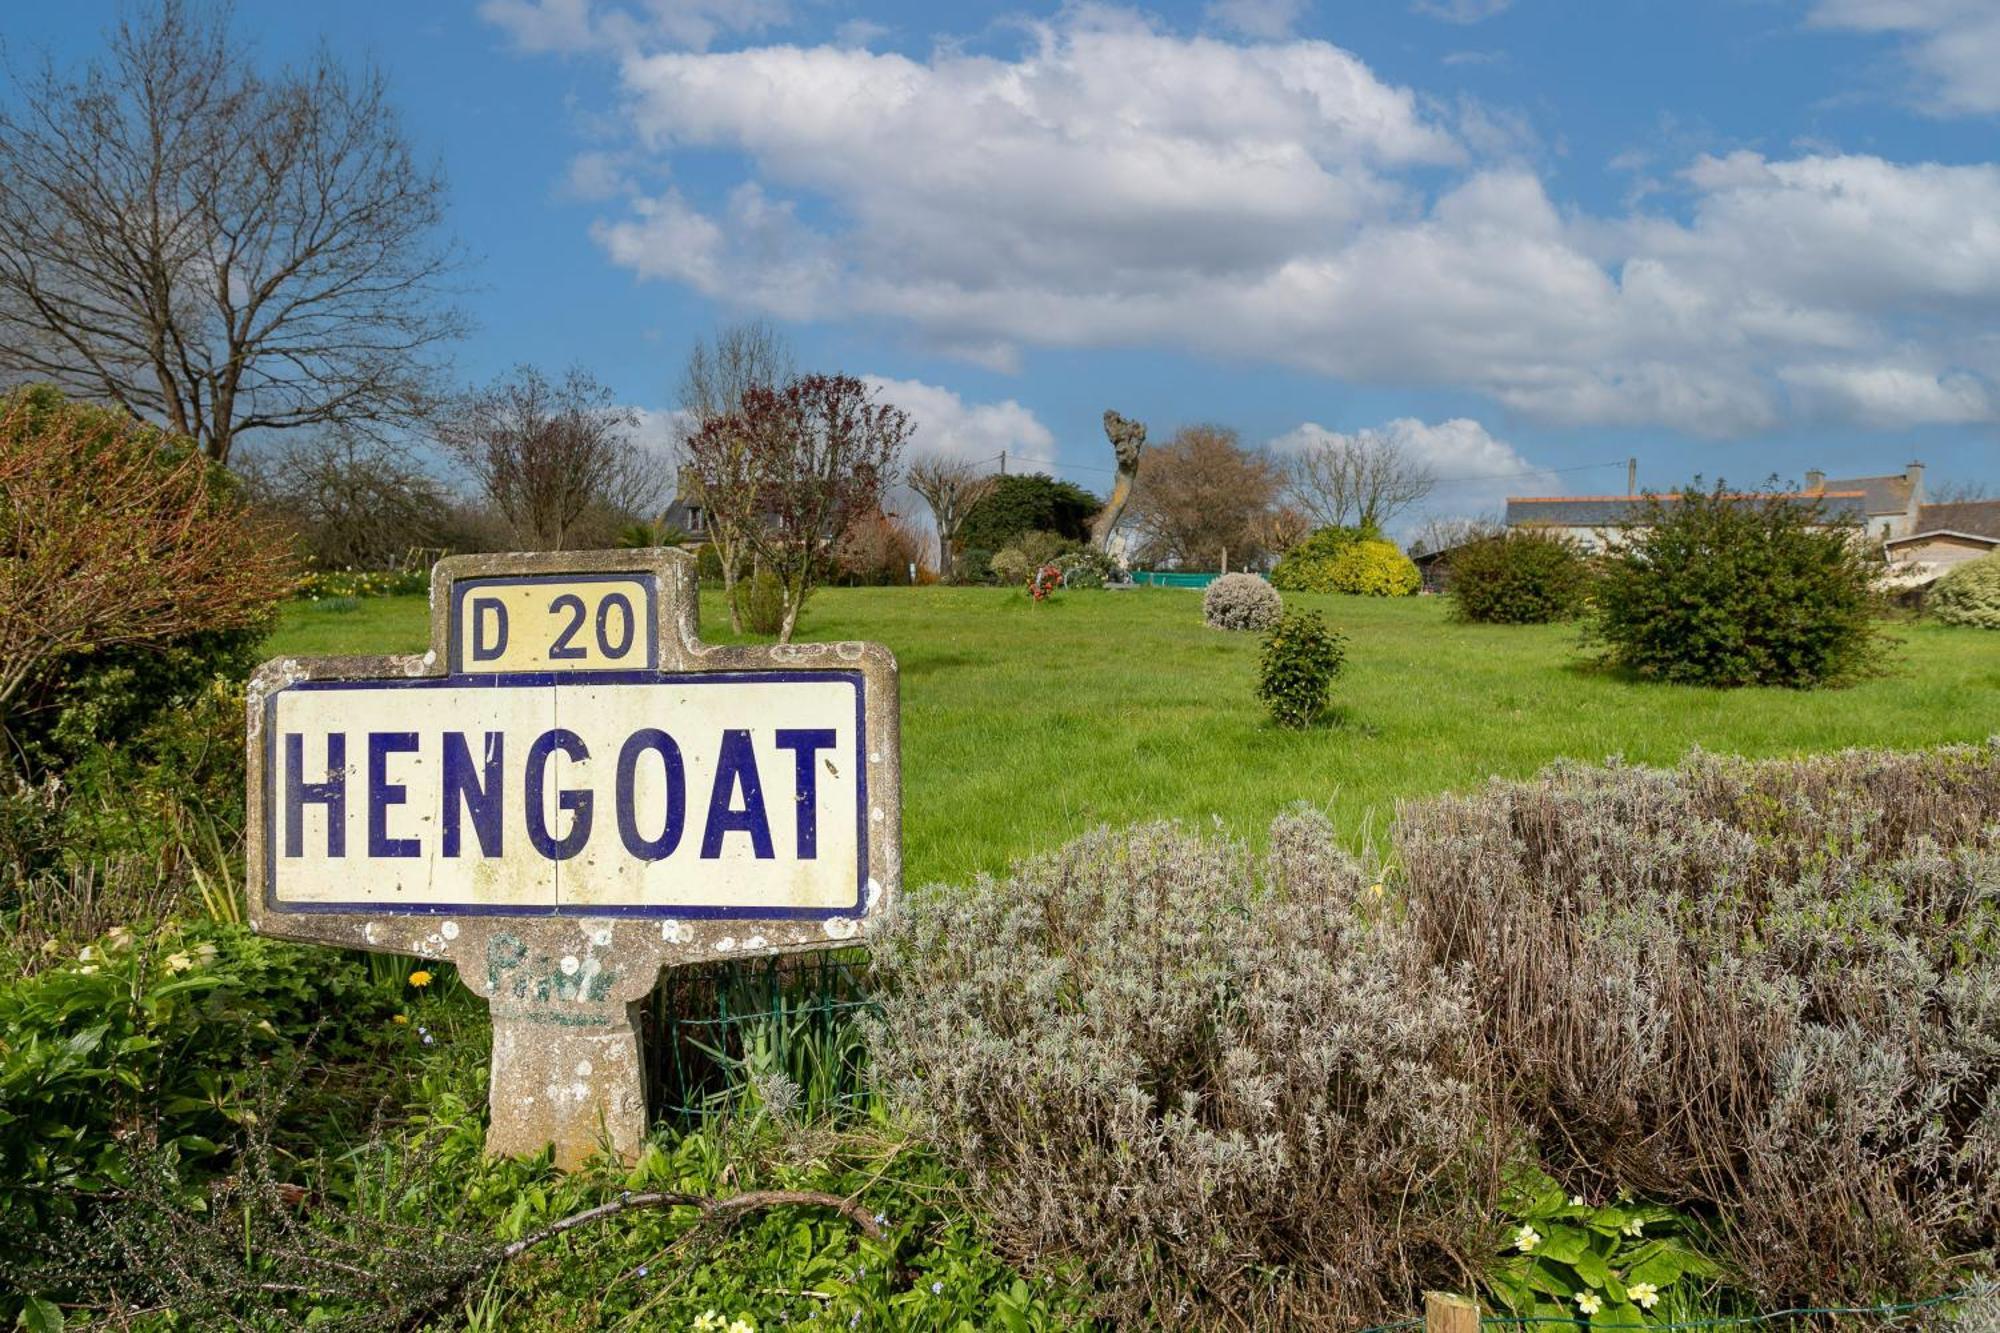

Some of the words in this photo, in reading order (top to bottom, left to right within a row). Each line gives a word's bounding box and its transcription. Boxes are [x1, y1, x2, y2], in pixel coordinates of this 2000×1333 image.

[473, 597, 508, 661] D
[549, 592, 635, 659] 20
[285, 728, 837, 861] HENGOAT
